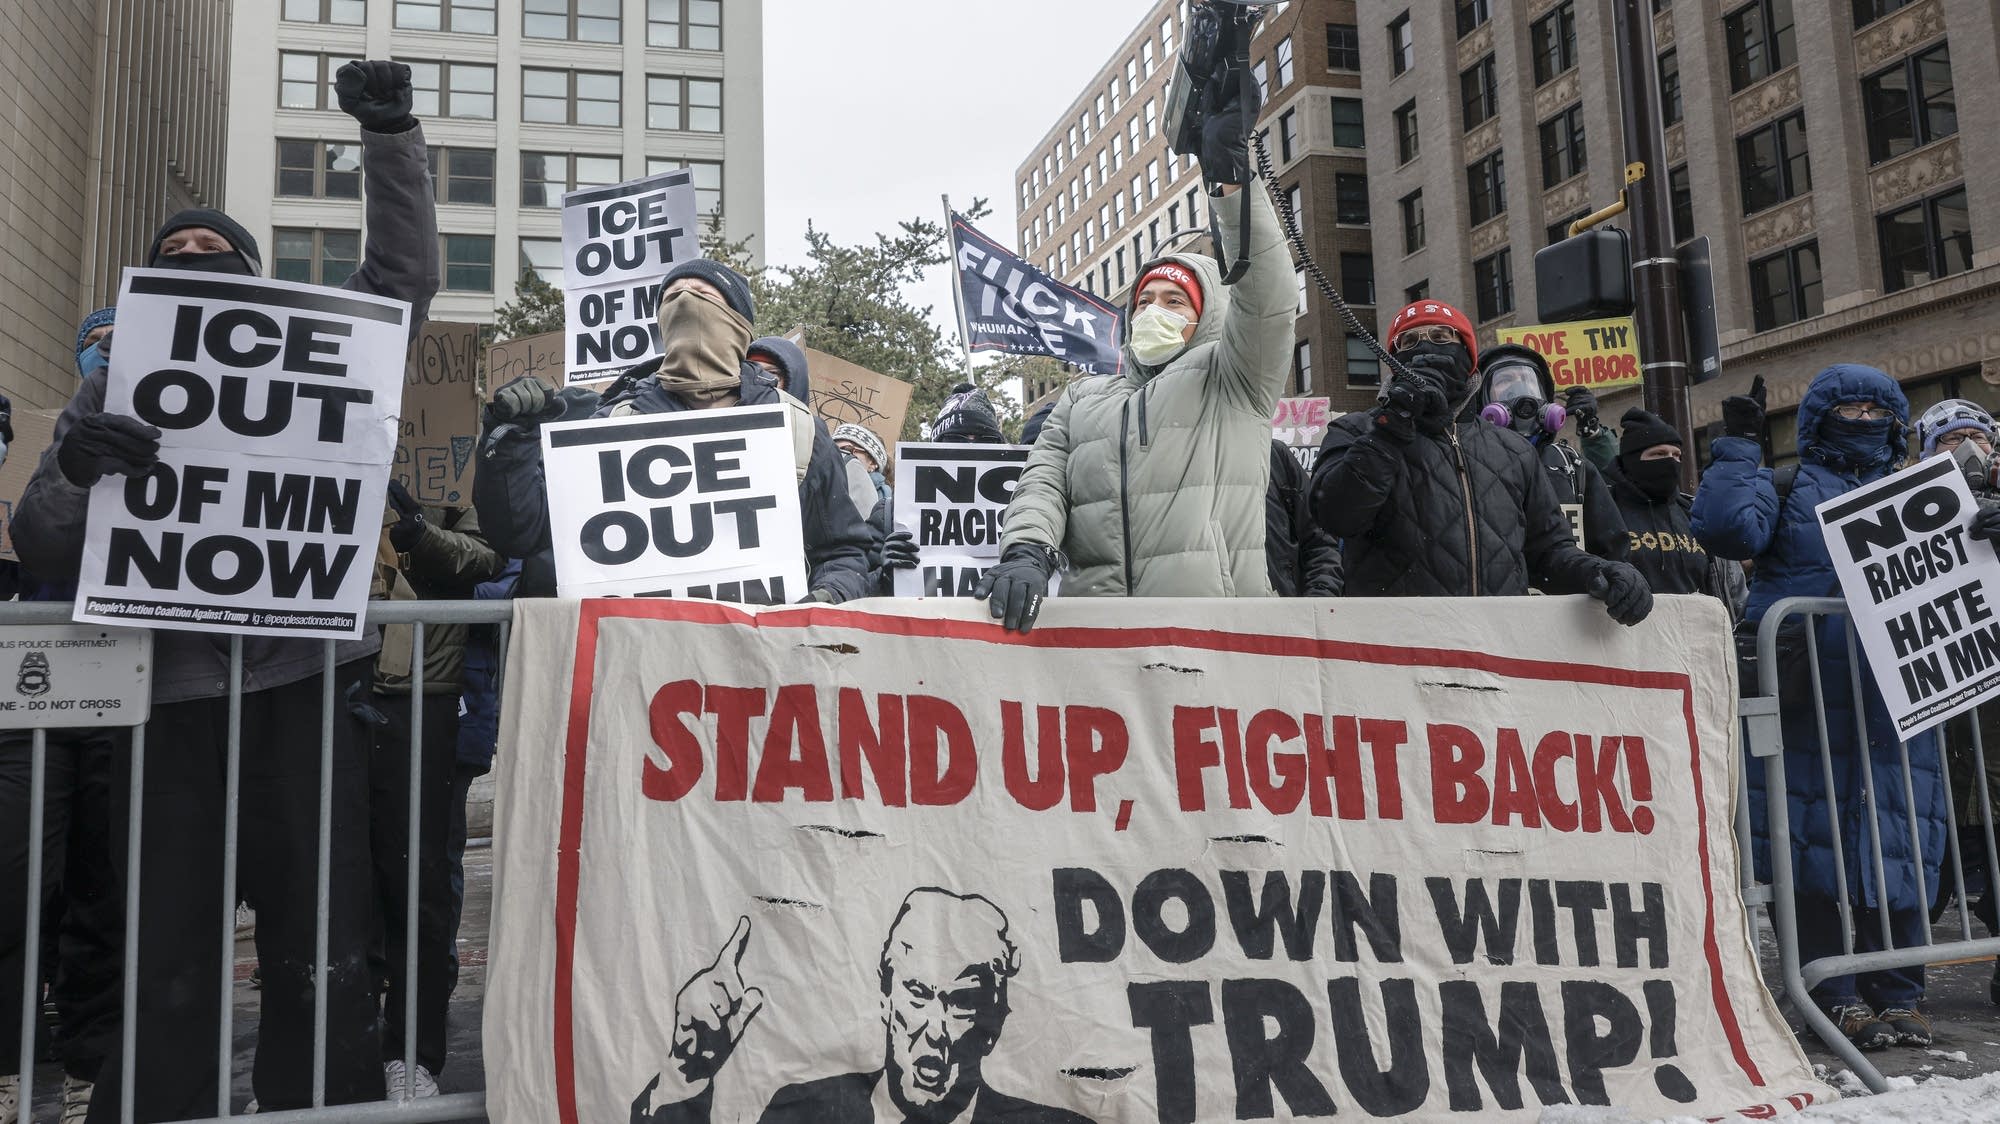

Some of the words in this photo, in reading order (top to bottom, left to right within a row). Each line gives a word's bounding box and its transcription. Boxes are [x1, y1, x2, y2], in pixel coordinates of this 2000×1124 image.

[588, 192, 668, 239] ICE
[576, 228, 683, 276] OUT
[580, 290, 625, 327] OF
[633, 284, 662, 320] M
[170, 304, 354, 377] ICE
[491, 345, 565, 384] Protec
[1583, 326, 1628, 350] THY
[833, 381, 880, 404] SALT
[1548, 354, 1638, 385] GHBOR
[133, 369, 374, 443] OUT
[1272, 399, 1328, 427] OVE
[124, 461, 229, 524] OF
[242, 470, 361, 535] MN
[598, 438, 750, 503] ICE
[580, 495, 777, 565] OUT
[920, 509, 1006, 546] RACI
[1840, 485, 1961, 563] NO
[104, 528, 360, 600] NOW
[923, 566, 995, 597] HA
[1862, 524, 1968, 605] RACIST
[88, 601, 126, 614] People's
[126, 603, 154, 615] Action
[155, 606, 191, 618] Coalition
[192, 608, 223, 621] Against
[224, 610, 248, 623] Trump
[1885, 579, 1993, 659] HATE
[18, 640, 52, 649] POLICE
[55, 639, 117, 648] DEPARTMENT
[1898, 651, 1948, 704] IN
[1944, 622, 2000, 684] MN
[0, 702, 17, 710] NE
[28, 701, 47, 710] DO
[51, 700, 76, 709] NOT
[79, 699, 121, 709] CROSS
[642, 679, 978, 808] STAND
[1000, 699, 1134, 832] UP,
[1173, 705, 1408, 820] FIGHT
[1427, 723, 1655, 835] BACK!
[1052, 868, 1404, 963] DOWN
[1425, 877, 1669, 968] WITH
[1127, 977, 1697, 1124] TRUMP!
